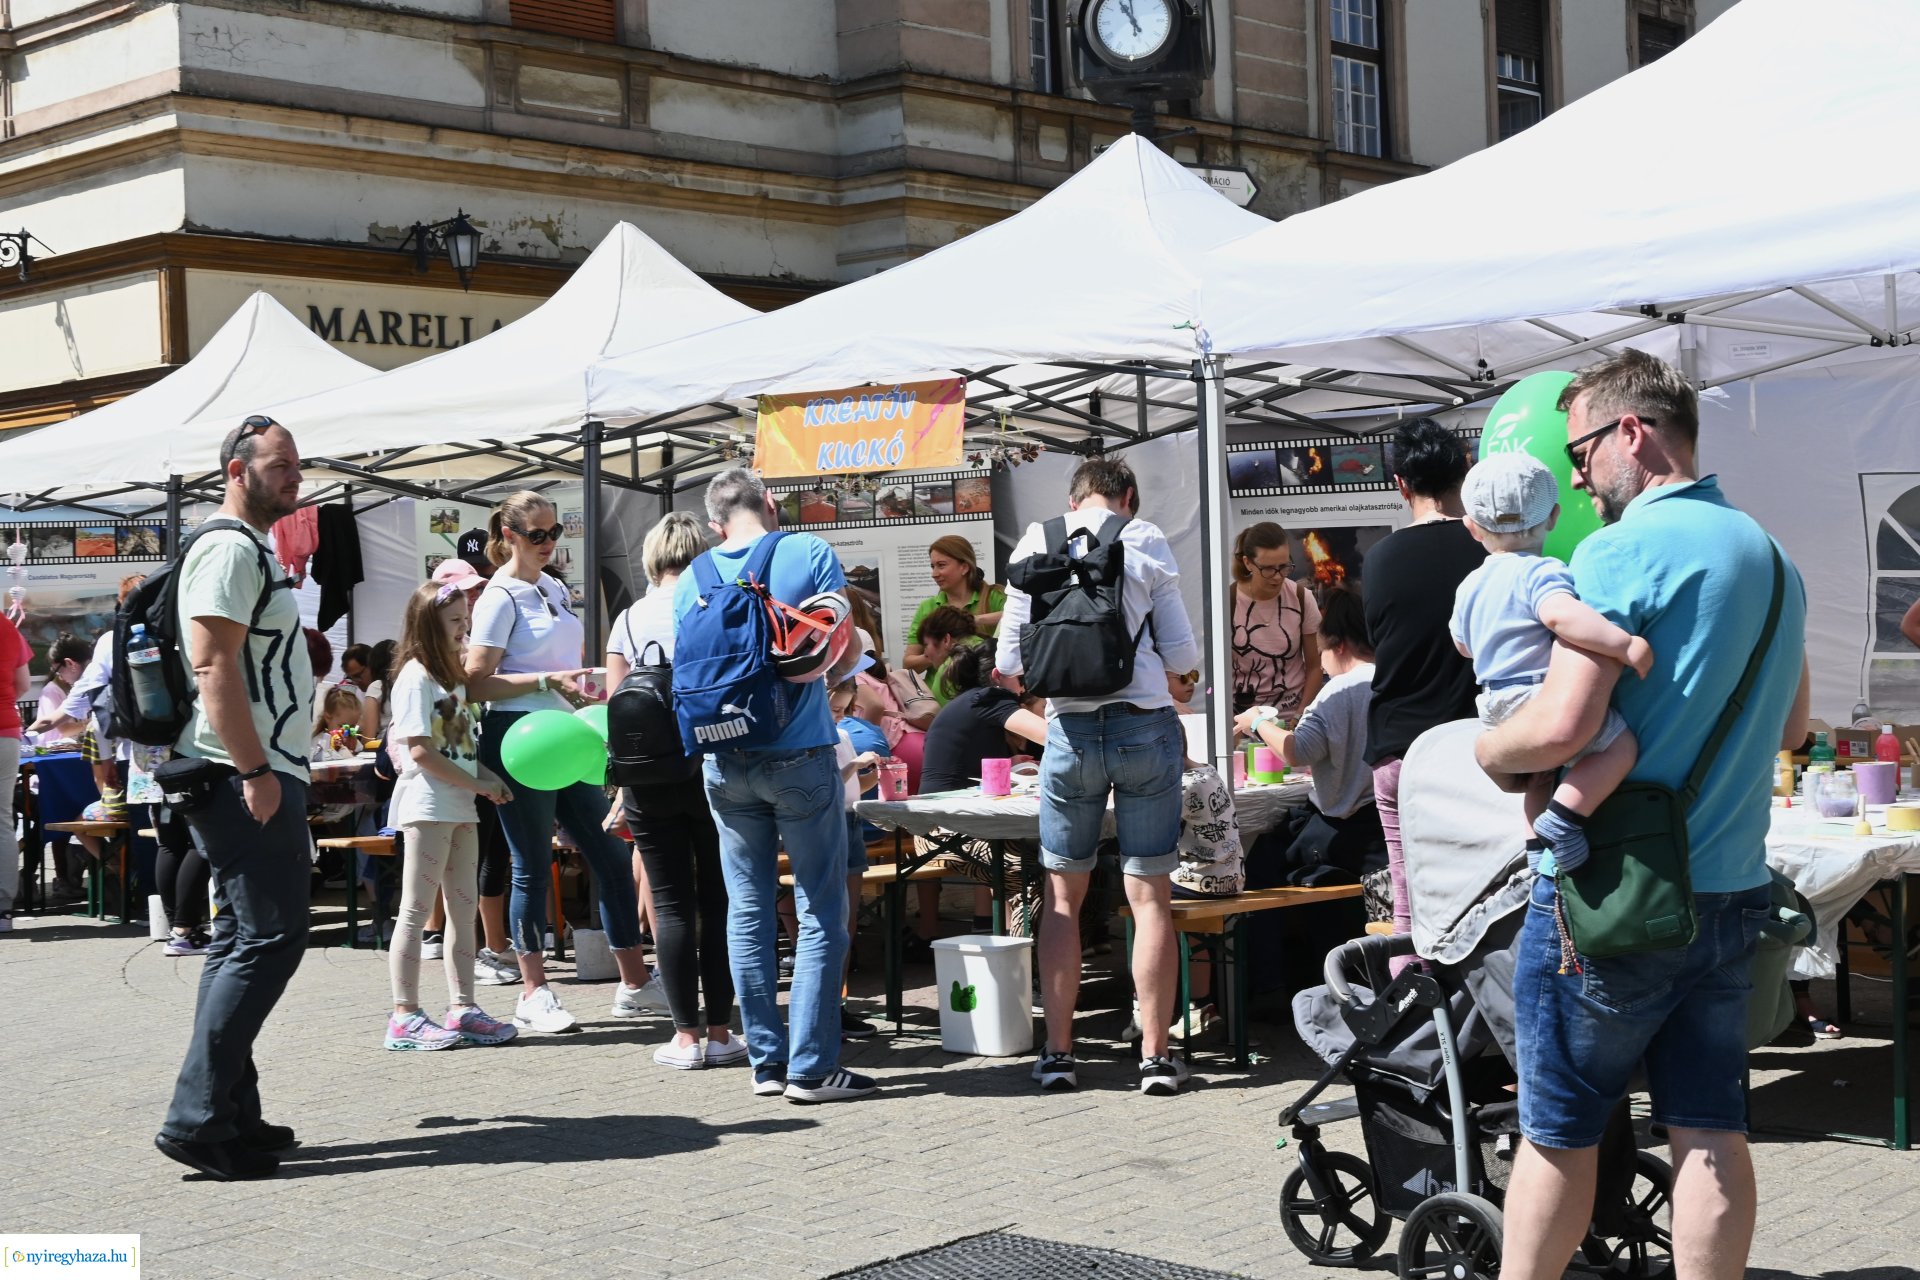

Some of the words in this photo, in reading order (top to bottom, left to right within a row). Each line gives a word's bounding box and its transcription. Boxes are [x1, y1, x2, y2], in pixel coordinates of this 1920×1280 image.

[816, 429, 905, 470] KUCKÓ
[1280, 506, 1319, 515] legnagyobb
[1320, 505, 1348, 513] amerikai
[694, 716, 749, 744] PUMA
